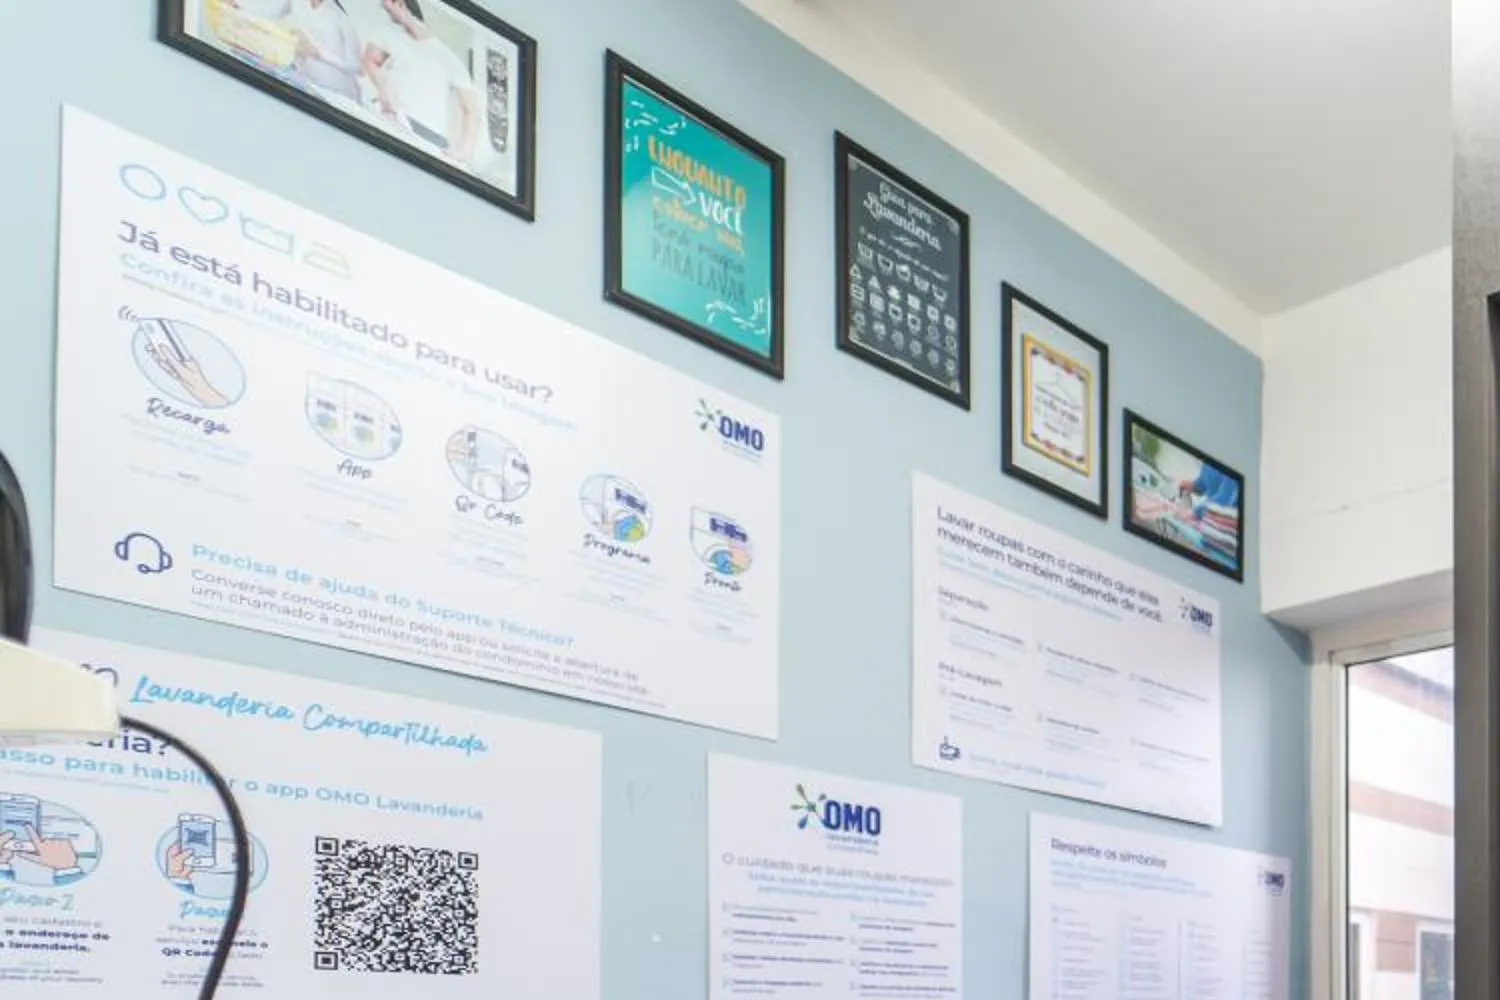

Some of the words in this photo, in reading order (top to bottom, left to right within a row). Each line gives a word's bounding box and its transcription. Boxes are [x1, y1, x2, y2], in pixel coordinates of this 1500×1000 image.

[117, 219, 160, 254] Já
[169, 246, 242, 286] está
[252, 272, 409, 349] habilitado
[416, 341, 476, 377] para
[485, 366, 553, 404] usar?
[147, 396, 231, 435] Recarga
[718, 415, 765, 452] OMO
[336, 457, 374, 480] App
[979, 524, 1025, 553] roupas
[191, 569, 278, 600] Converse
[281, 590, 354, 617] conosco
[357, 607, 406, 629] direto
[192, 543, 278, 576] Precisa
[285, 567, 312, 584] de
[318, 578, 379, 602] ajuda
[192, 585, 224, 602] um
[228, 591, 316, 624] chamado
[332, 615, 449, 653] administração
[128, 675, 294, 720] Lavanderia
[303, 702, 489, 757] Compartilhada
[63, 755, 125, 773] para
[244, 780, 259, 792] o
[265, 783, 310, 800] app
[315, 786, 370, 807] OMO
[376, 795, 485, 822] Lavanderia
[823, 799, 882, 837] OMO
